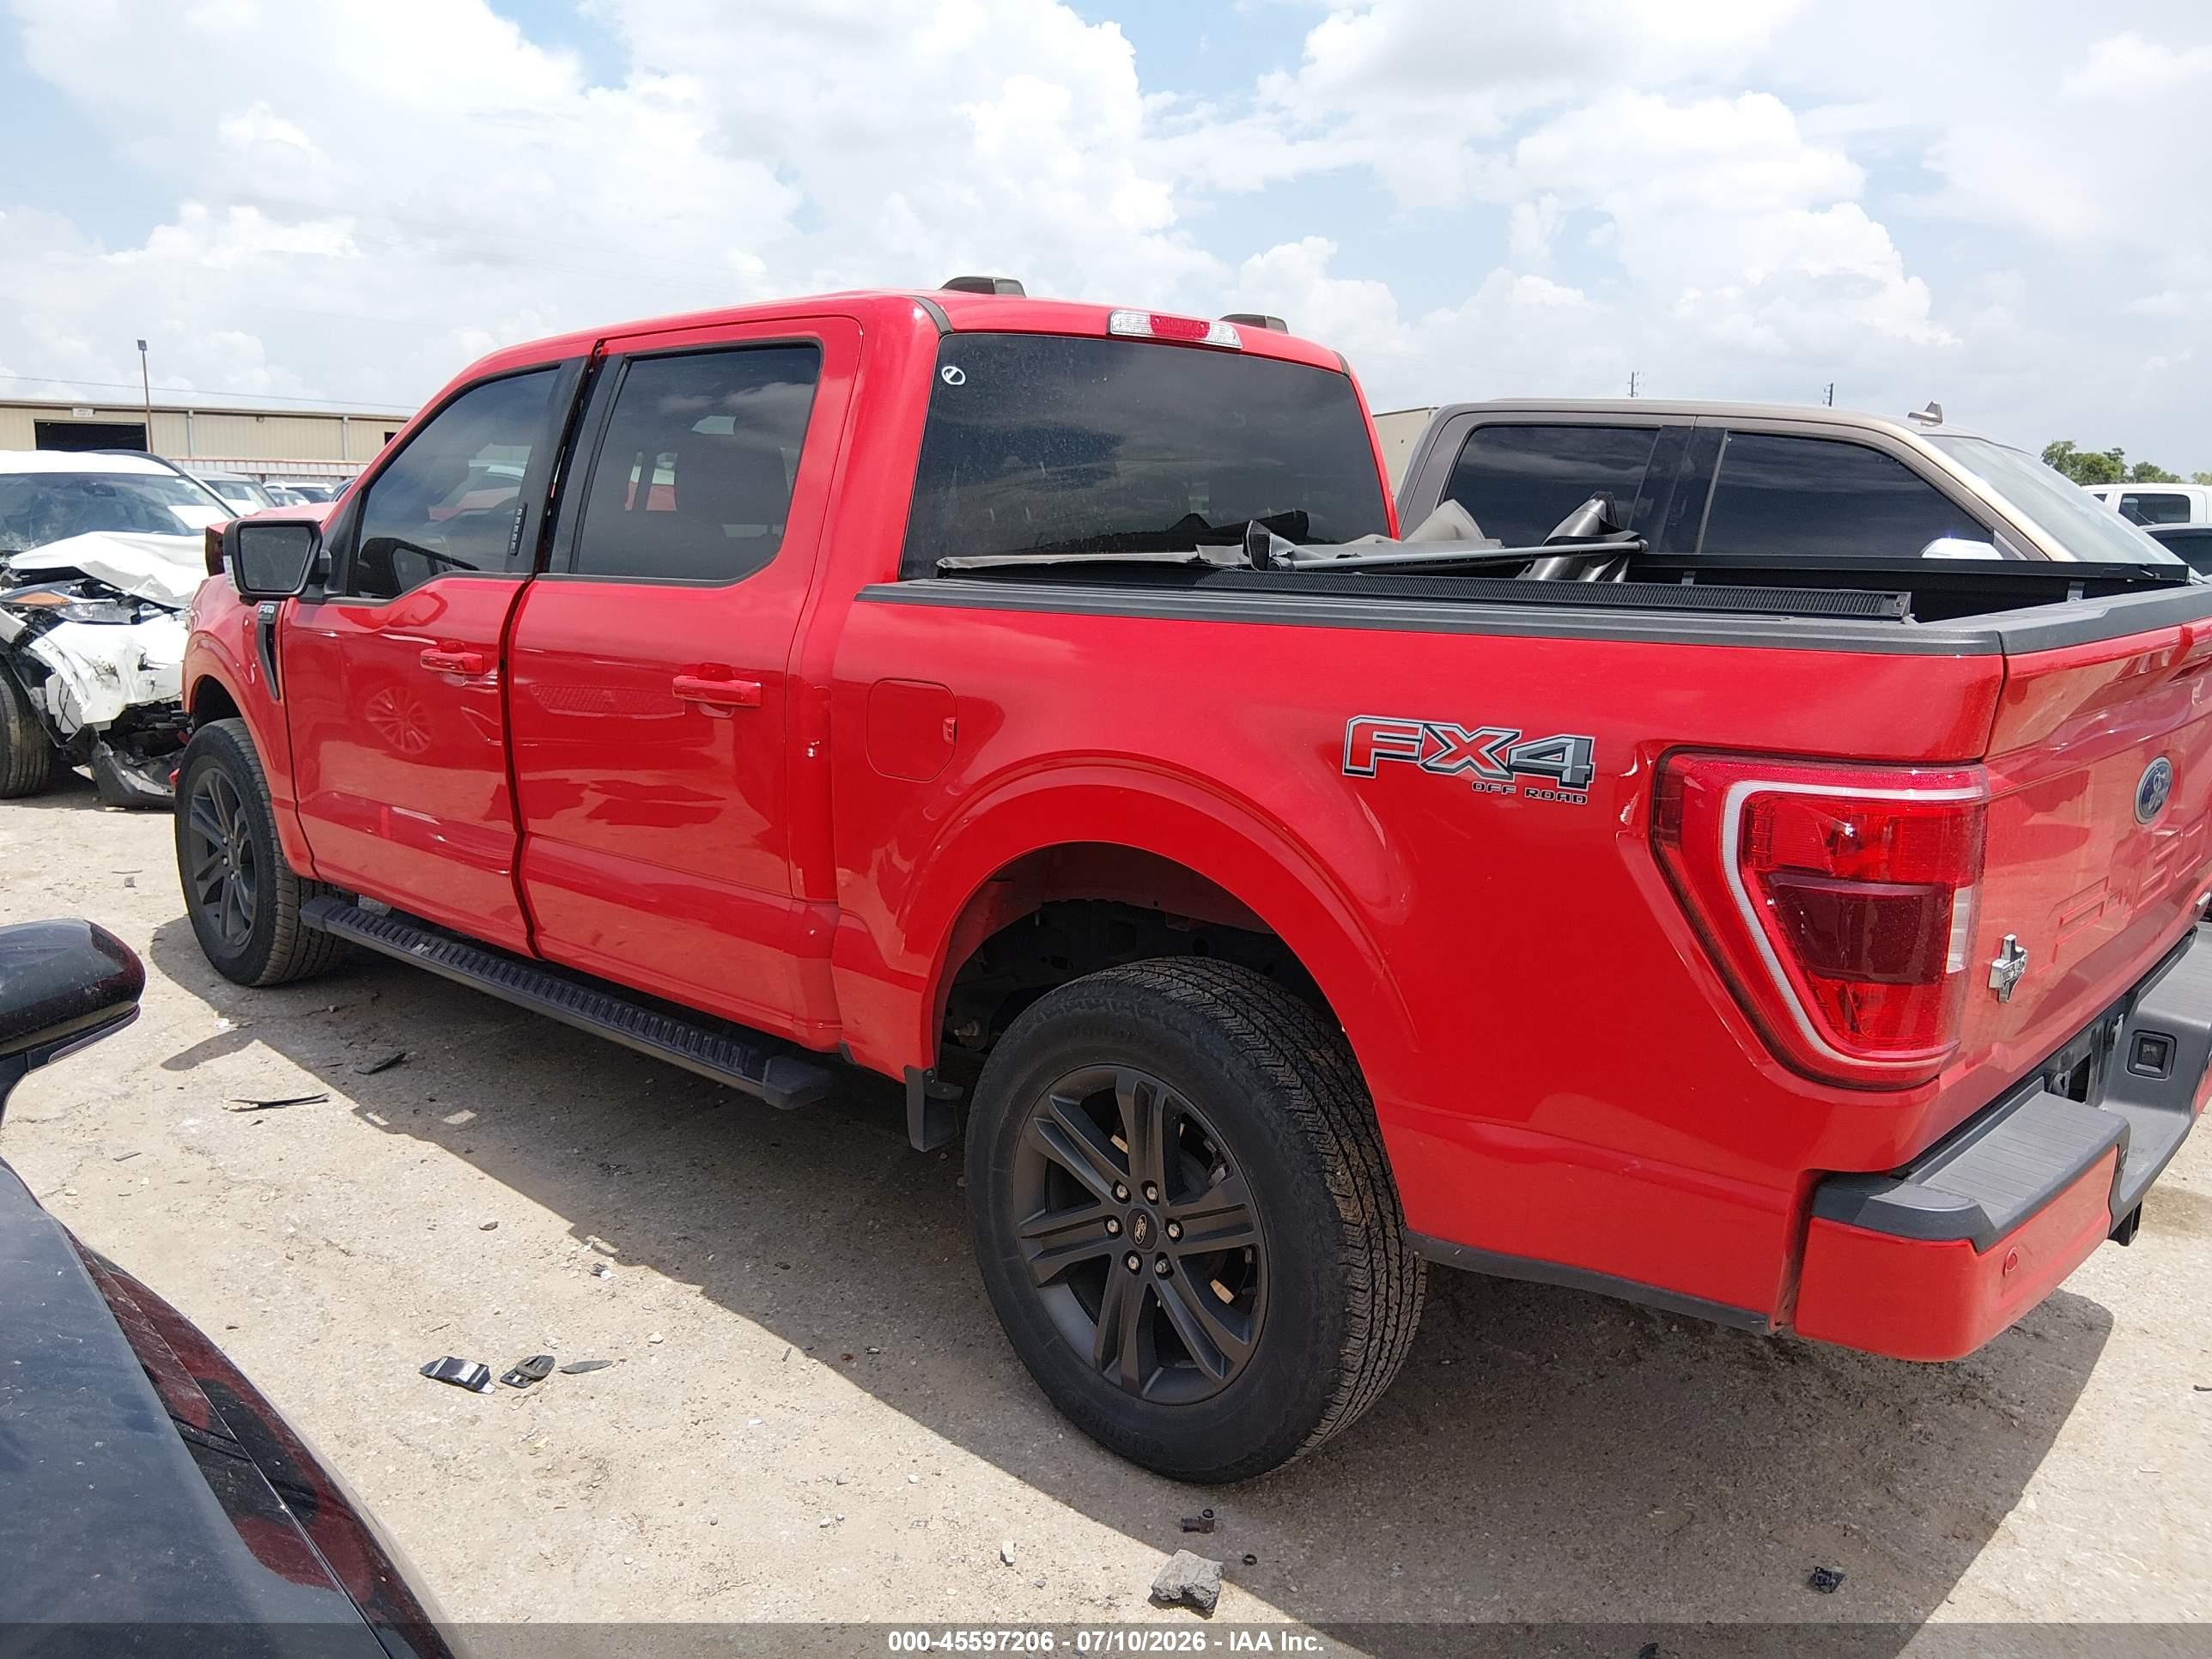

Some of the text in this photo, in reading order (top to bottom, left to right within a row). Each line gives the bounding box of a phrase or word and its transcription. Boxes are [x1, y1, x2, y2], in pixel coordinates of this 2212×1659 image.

[1343, 715, 1595, 791] FX4
[1472, 781, 1588, 805] OFF ROAD
